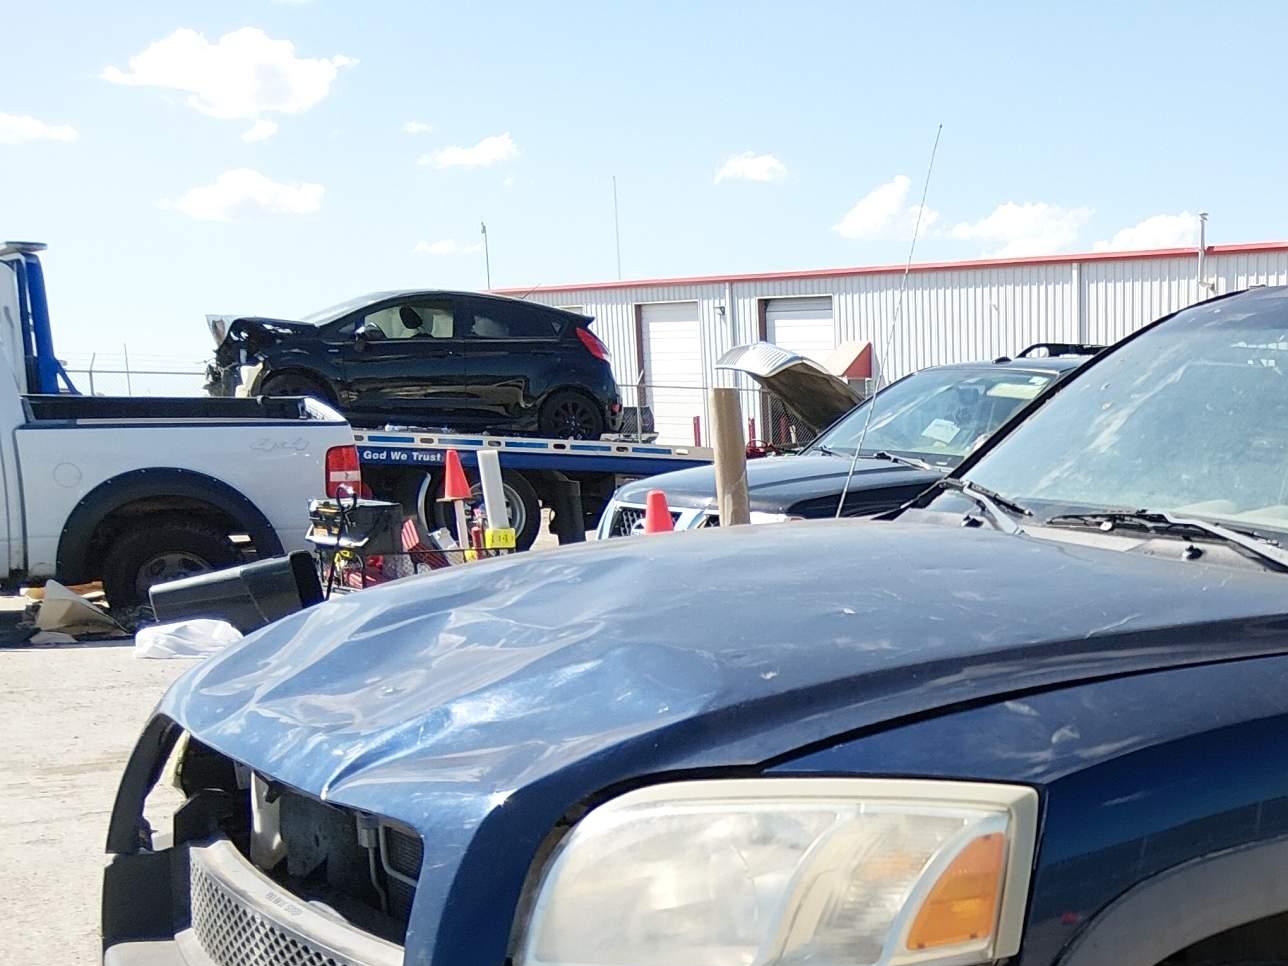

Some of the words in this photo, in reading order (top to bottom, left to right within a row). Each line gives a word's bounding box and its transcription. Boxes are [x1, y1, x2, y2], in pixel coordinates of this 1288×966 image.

[362, 450, 387, 460] God
[390, 451, 408, 460] We
[411, 452, 442, 462] Trust
